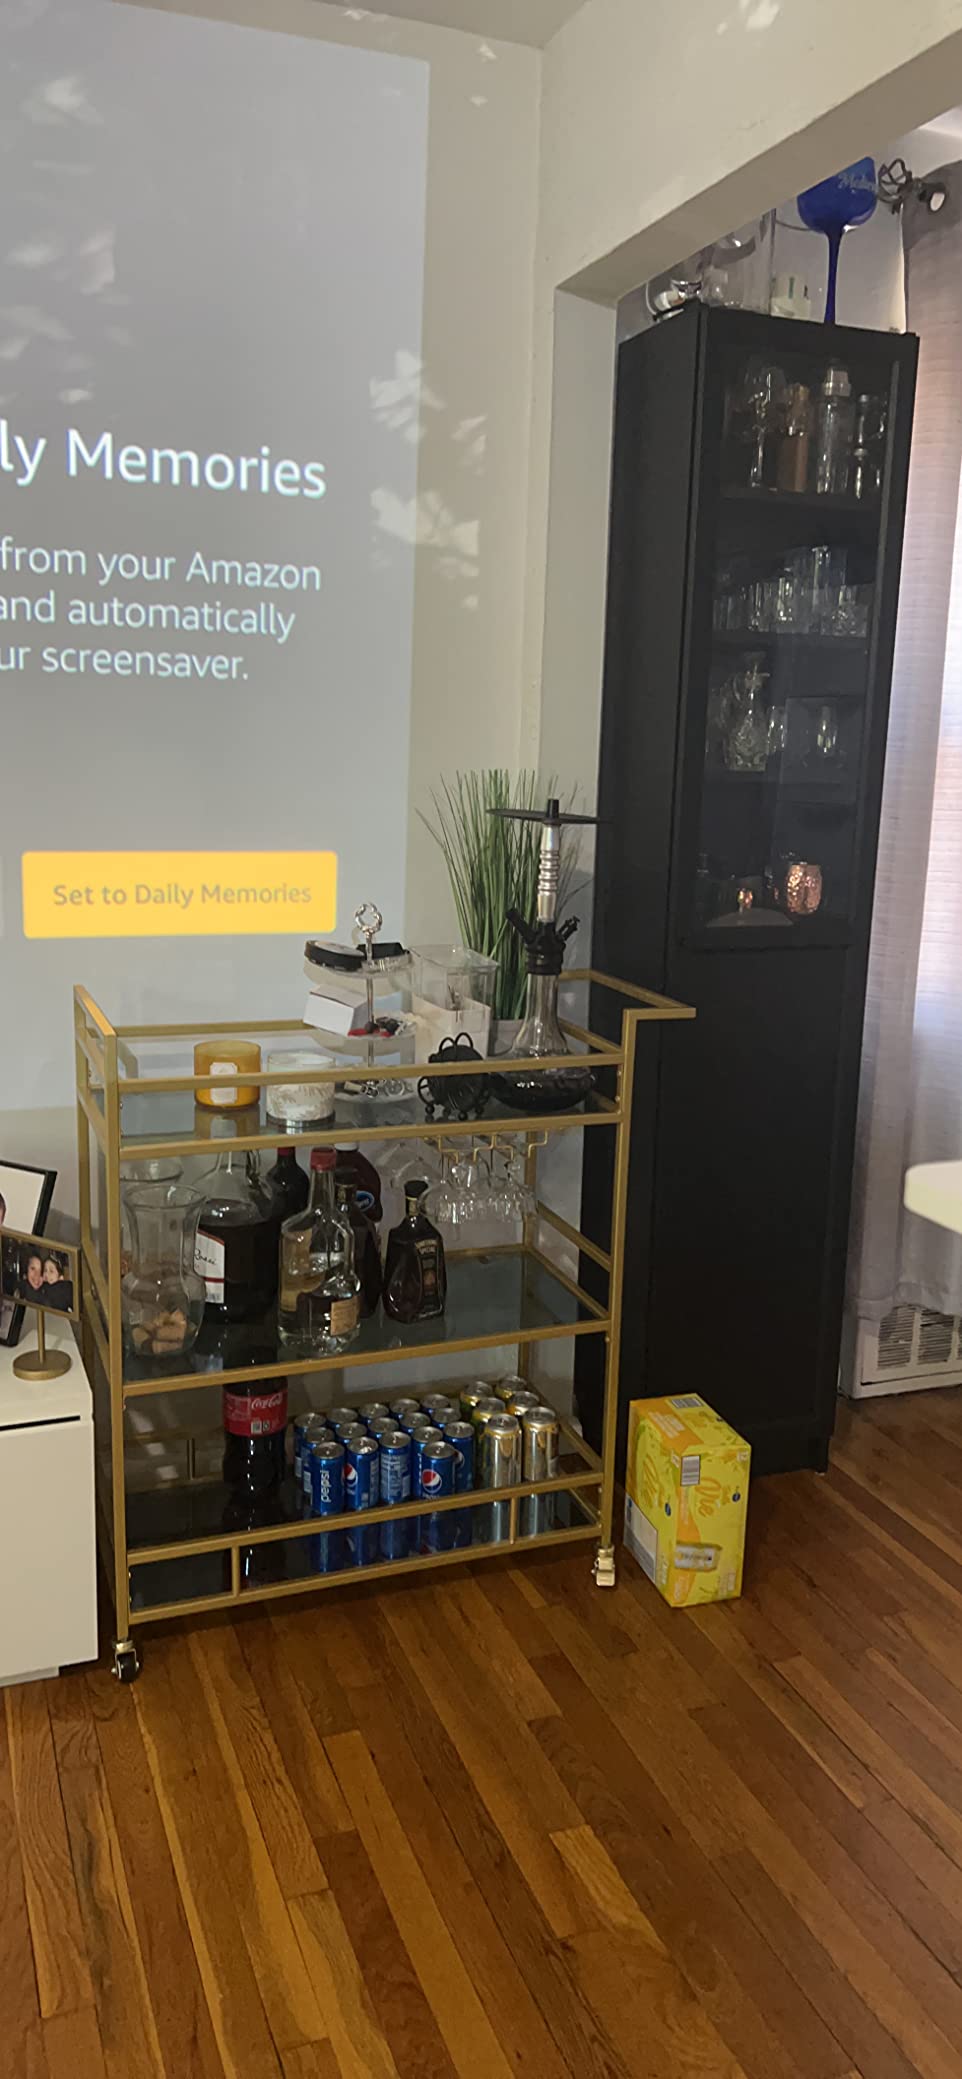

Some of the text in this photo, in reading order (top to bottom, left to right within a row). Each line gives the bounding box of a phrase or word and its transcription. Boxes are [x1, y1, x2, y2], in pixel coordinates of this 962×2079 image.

[67, 428, 326, 499] Memories
[0, 536, 321, 590] from your Amazon
[0, 589, 296, 644] and automatically
[42, 646, 249, 680] screensaver.
[53, 883, 312, 909] Set to Daily Memories
[320, 1470, 332, 1502] pepsi
